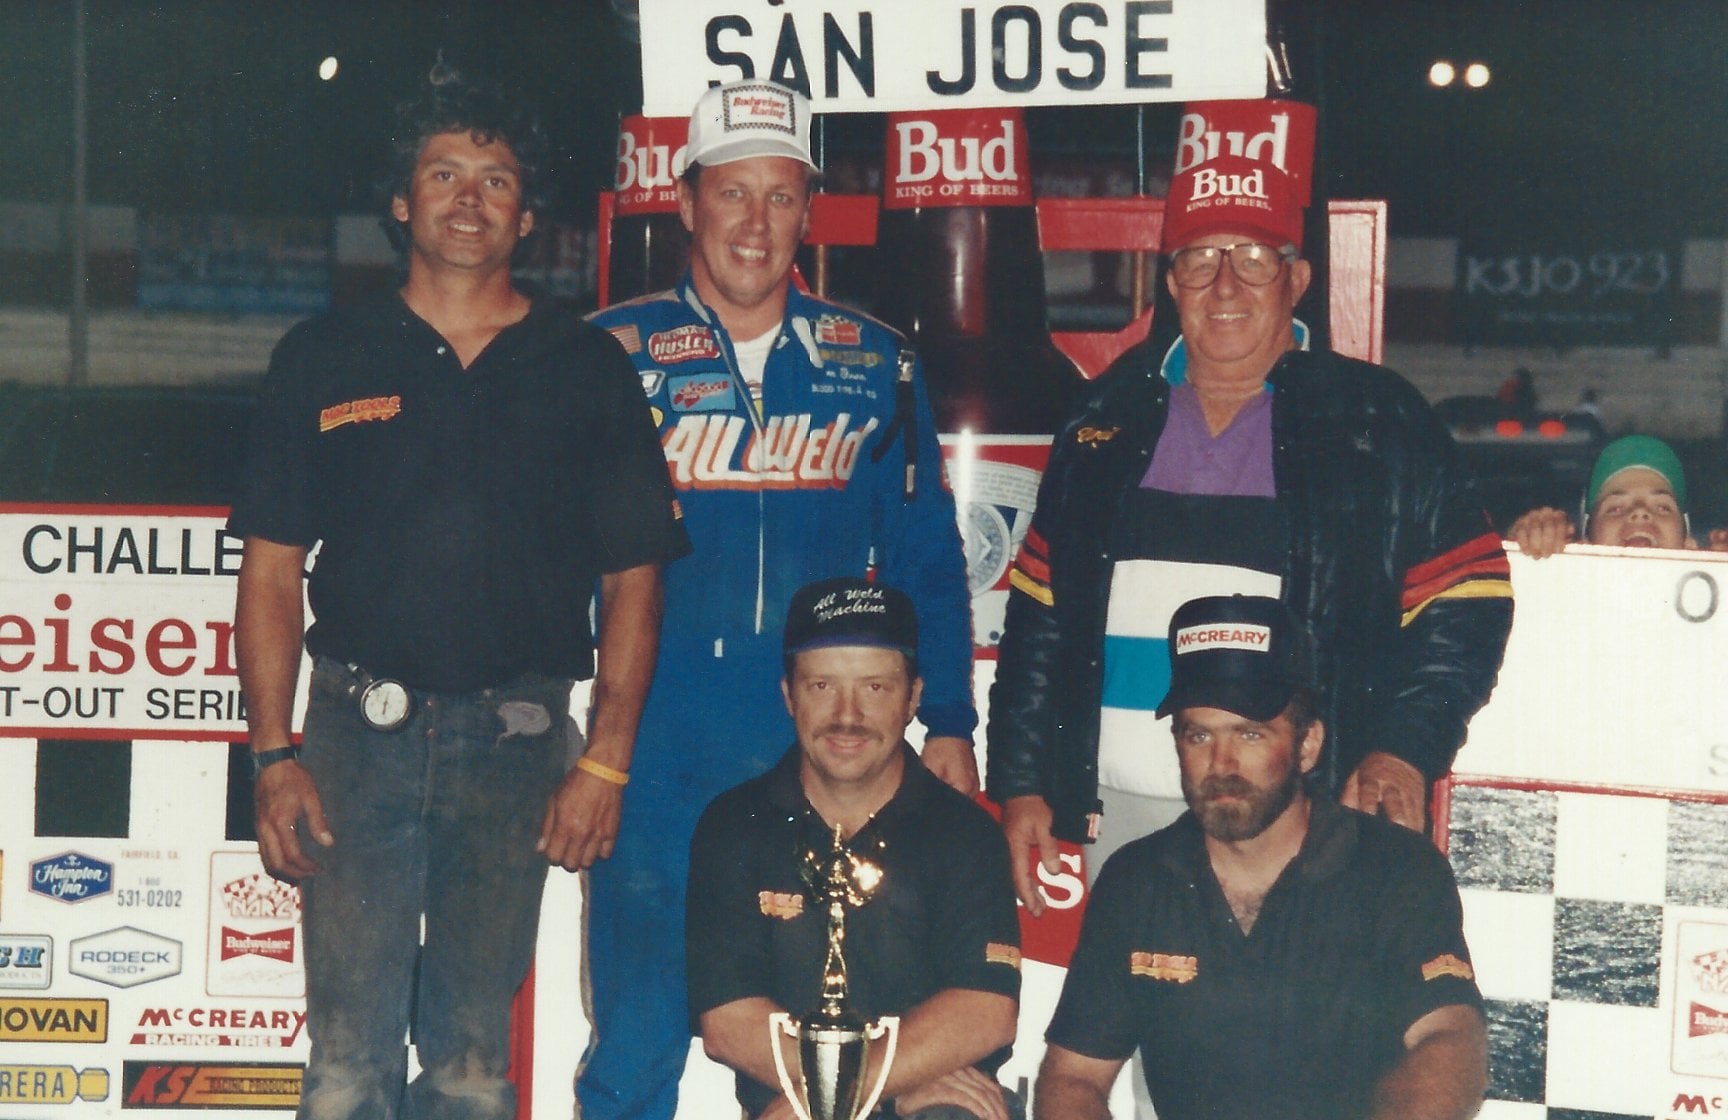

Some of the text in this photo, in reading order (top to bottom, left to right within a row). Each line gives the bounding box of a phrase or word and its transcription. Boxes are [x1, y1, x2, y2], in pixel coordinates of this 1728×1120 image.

[705, 0, 1172, 98] SAN JOSE
[896, 120, 1018, 183] Bud
[896, 184, 1019, 198] KING OF BEERS
[1190, 168, 1269, 200] Bud
[1186, 199, 1211, 213] KING
[1215, 197, 1230, 206] OF
[22, 524, 245, 575] CHALLE
[813, 588, 884, 613] All Weld
[817, 599, 886, 624] Machine
[36, 864, 108, 884] Hampton
[52, 880, 88, 897] Inn
[117, 889, 183, 907] 531-0202
[226, 936, 290, 950] Budweiser
[80, 951, 171, 963] RODECK
[0, 1006, 97, 1033] OVAN
[145, 1033, 282, 1047] RACING TIRES
